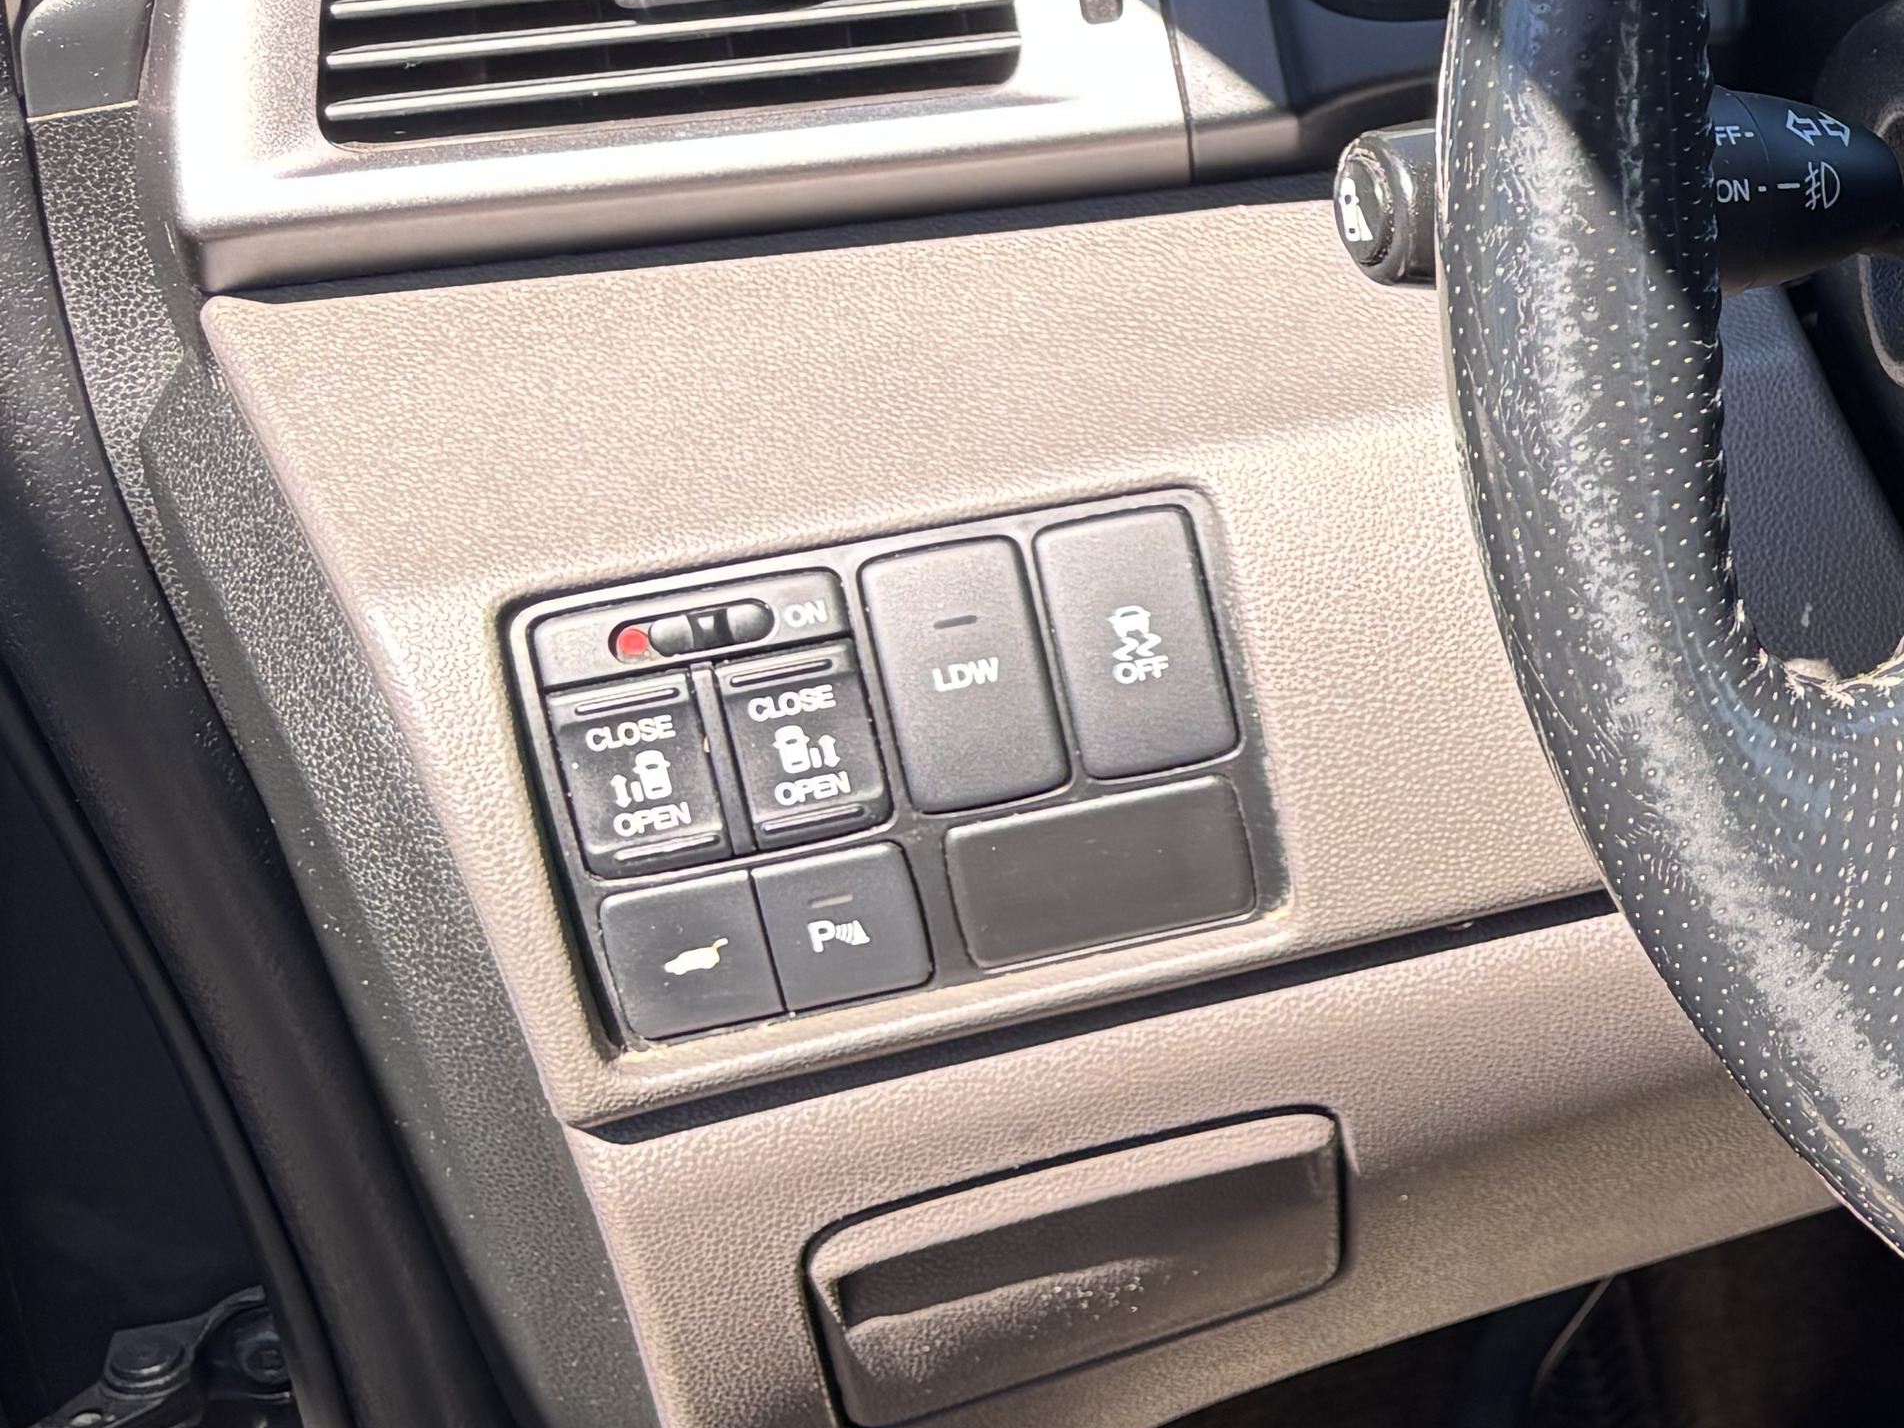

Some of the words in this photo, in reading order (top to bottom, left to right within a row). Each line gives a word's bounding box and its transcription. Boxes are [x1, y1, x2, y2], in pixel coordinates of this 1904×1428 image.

[1715, 126, 1742, 144] FF
[1716, 179, 1750, 203] ON
[783, 600, 827, 629] ON
[932, 657, 999, 692] LDW
[1112, 654, 1169, 686] OFF
[747, 685, 837, 724] CLOSE
[585, 714, 676, 752] CLOSE
[774, 772, 850, 807] OPEN
[612, 802, 691, 837] OPEN
